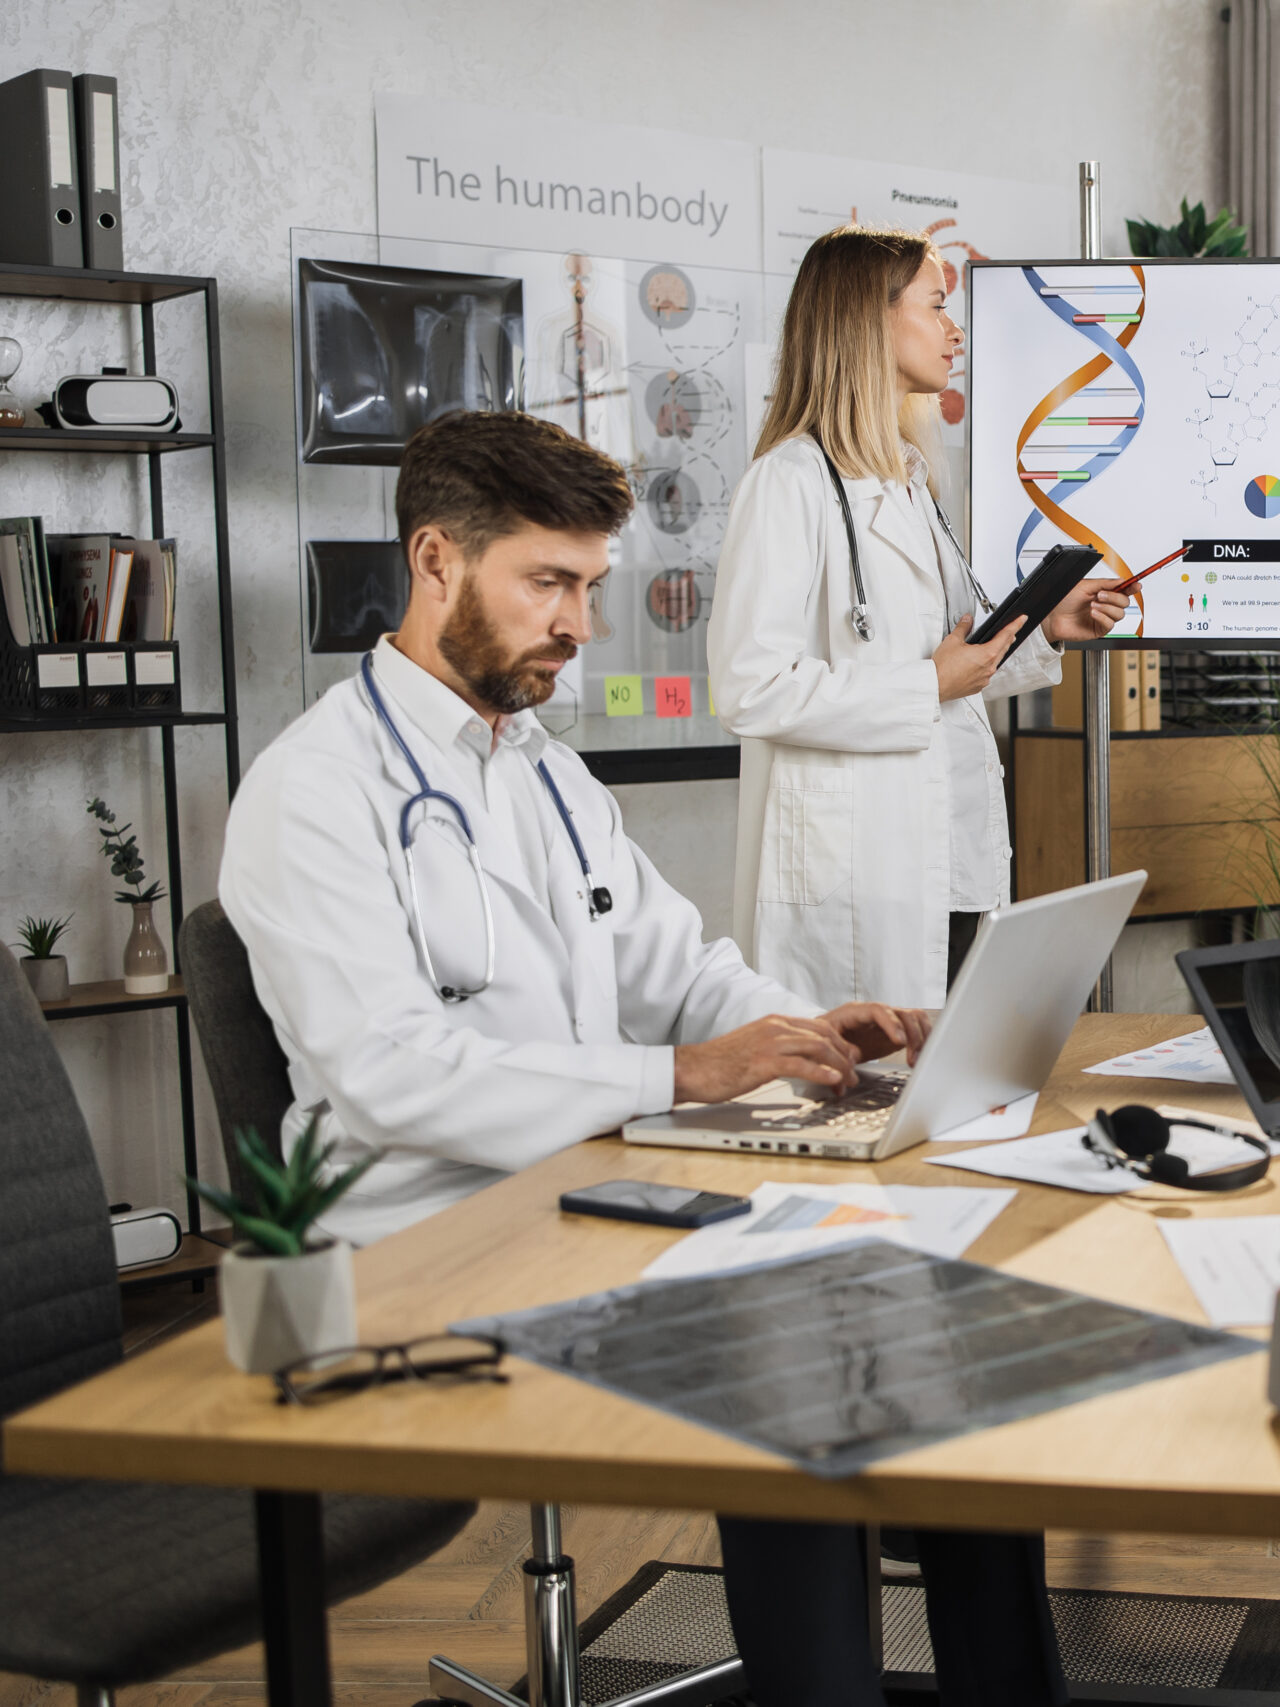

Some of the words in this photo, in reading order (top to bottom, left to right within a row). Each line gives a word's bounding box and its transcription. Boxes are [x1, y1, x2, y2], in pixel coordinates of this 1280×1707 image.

[406, 155, 481, 201] The
[496, 165, 728, 237] humanbody
[892, 189, 958, 209] Pneumonia
[1213, 544, 1250, 558] DNA:
[611, 686, 630, 704] NO
[665, 687, 686, 714] H2
